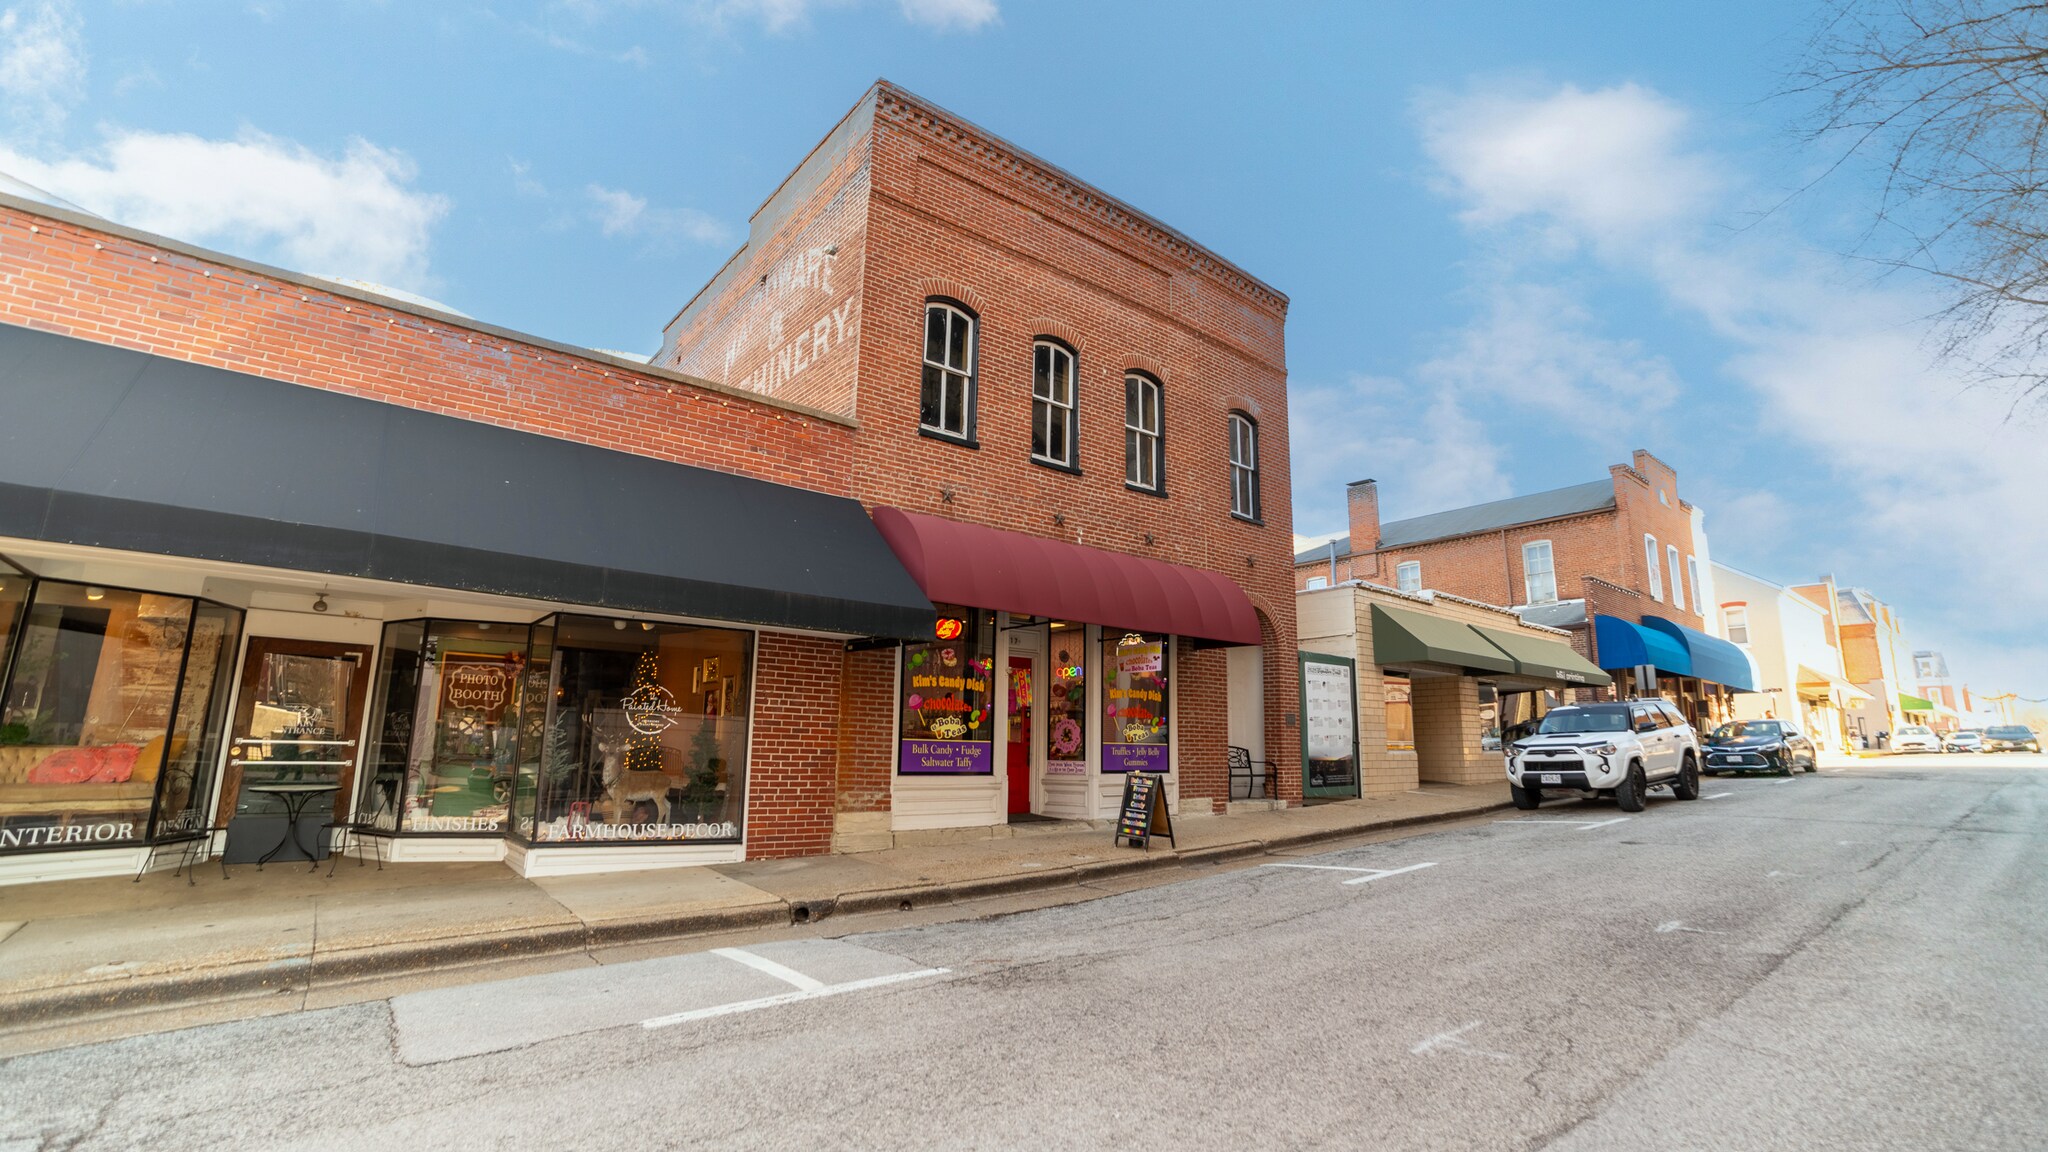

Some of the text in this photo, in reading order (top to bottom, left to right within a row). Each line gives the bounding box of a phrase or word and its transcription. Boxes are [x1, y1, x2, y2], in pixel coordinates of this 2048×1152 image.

[460, 673, 499, 686] PHOTO
[1055, 666, 1083, 680] open
[912, 674, 985, 692] Kim's Candy Dish
[453, 688, 500, 701] BOOTH
[620, 697, 683, 712] Painted Home
[937, 716, 960, 727] Boba
[275, 727, 326, 735] NTRANCE
[944, 725, 967, 737] Teas
[912, 744, 982, 758] Bulk Candy Fudge
[1111, 746, 1160, 758] Truffles Jelly Belly
[921, 757, 972, 770] Saltwater Taffy
[1123, 757, 1148, 766] Gummies
[411, 817, 499, 832] FINISHES
[548, 824, 668, 839] FARMHOUSE
[669, 822, 733, 838] DECOR
